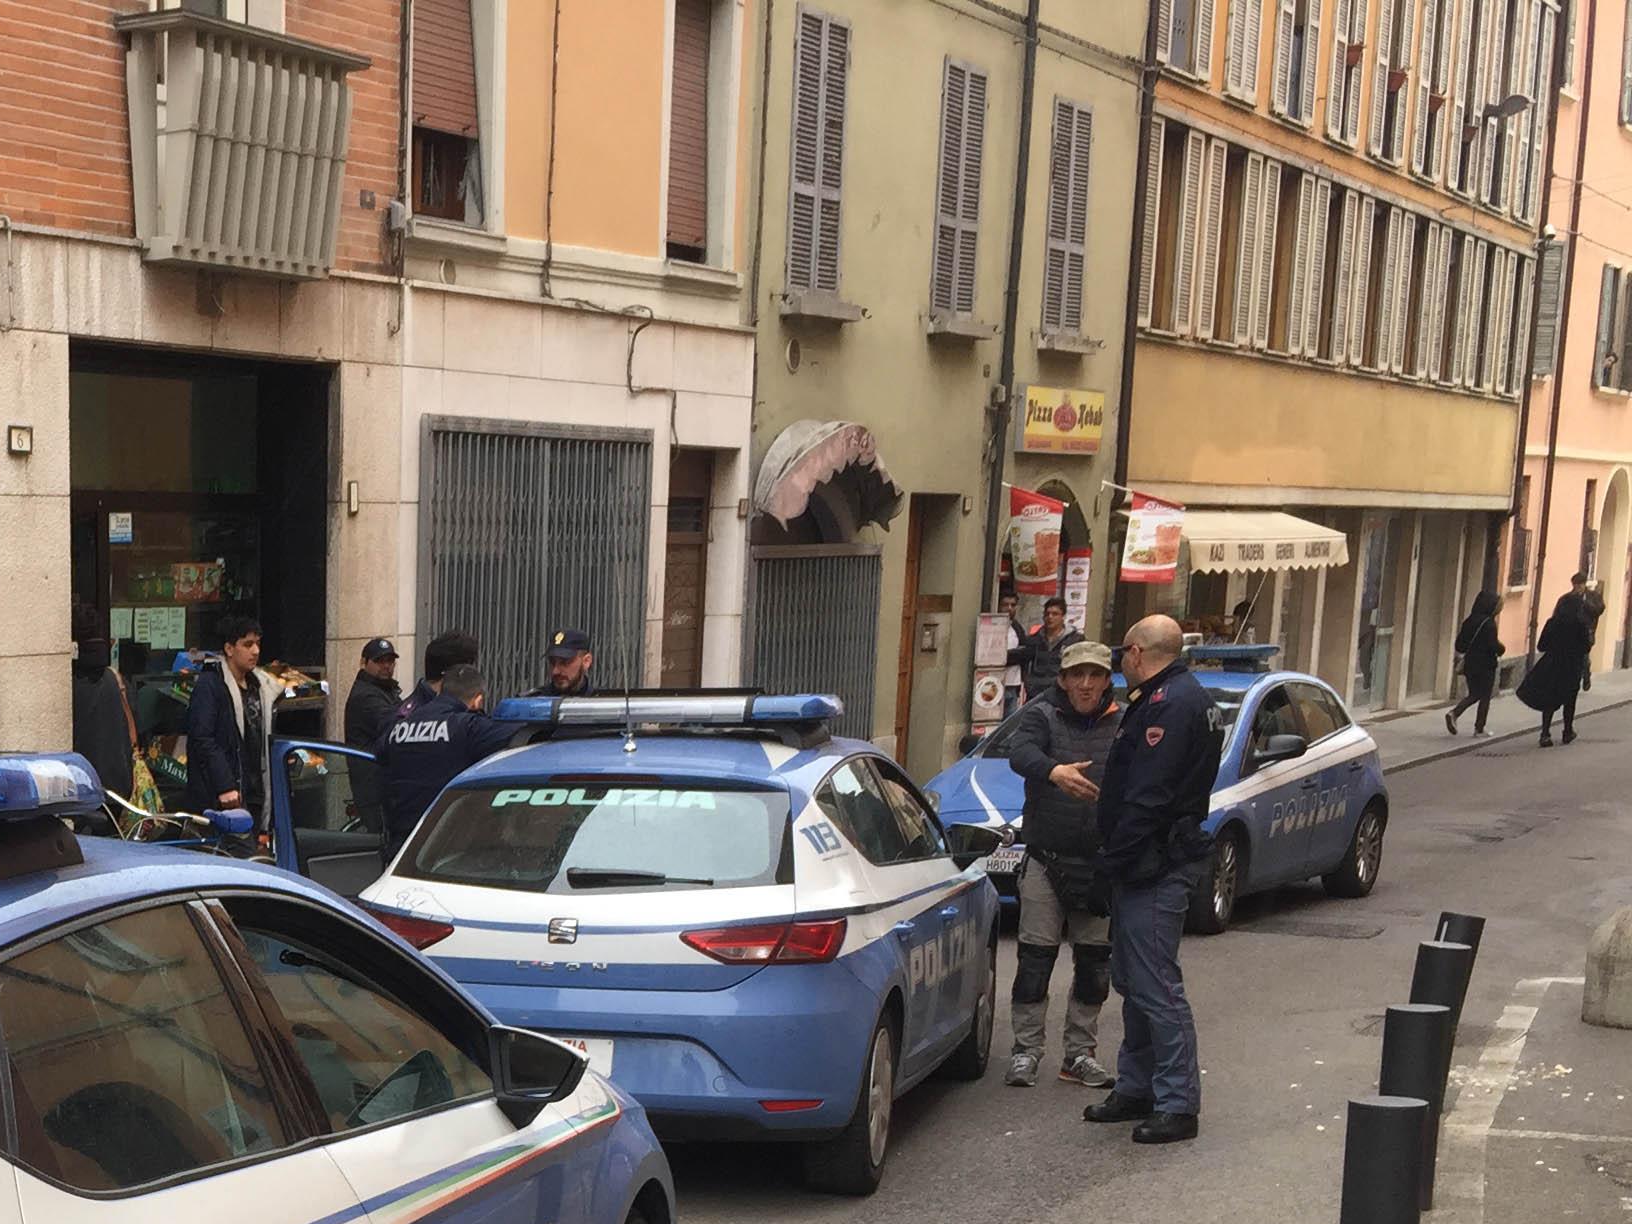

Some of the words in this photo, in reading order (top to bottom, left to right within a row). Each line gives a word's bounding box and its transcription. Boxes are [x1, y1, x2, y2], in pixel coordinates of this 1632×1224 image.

[1026, 399, 1052, 427] Pizza
[1078, 404, 1103, 429] Kebab
[17, 431, 24, 449] 6
[388, 720, 450, 744] POLIZIA
[491, 788, 717, 810] POLIZIA
[1268, 783, 1351, 839] POLIZIA
[799, 822, 842, 854] 113
[991, 851, 1020, 859] OLIZIA
